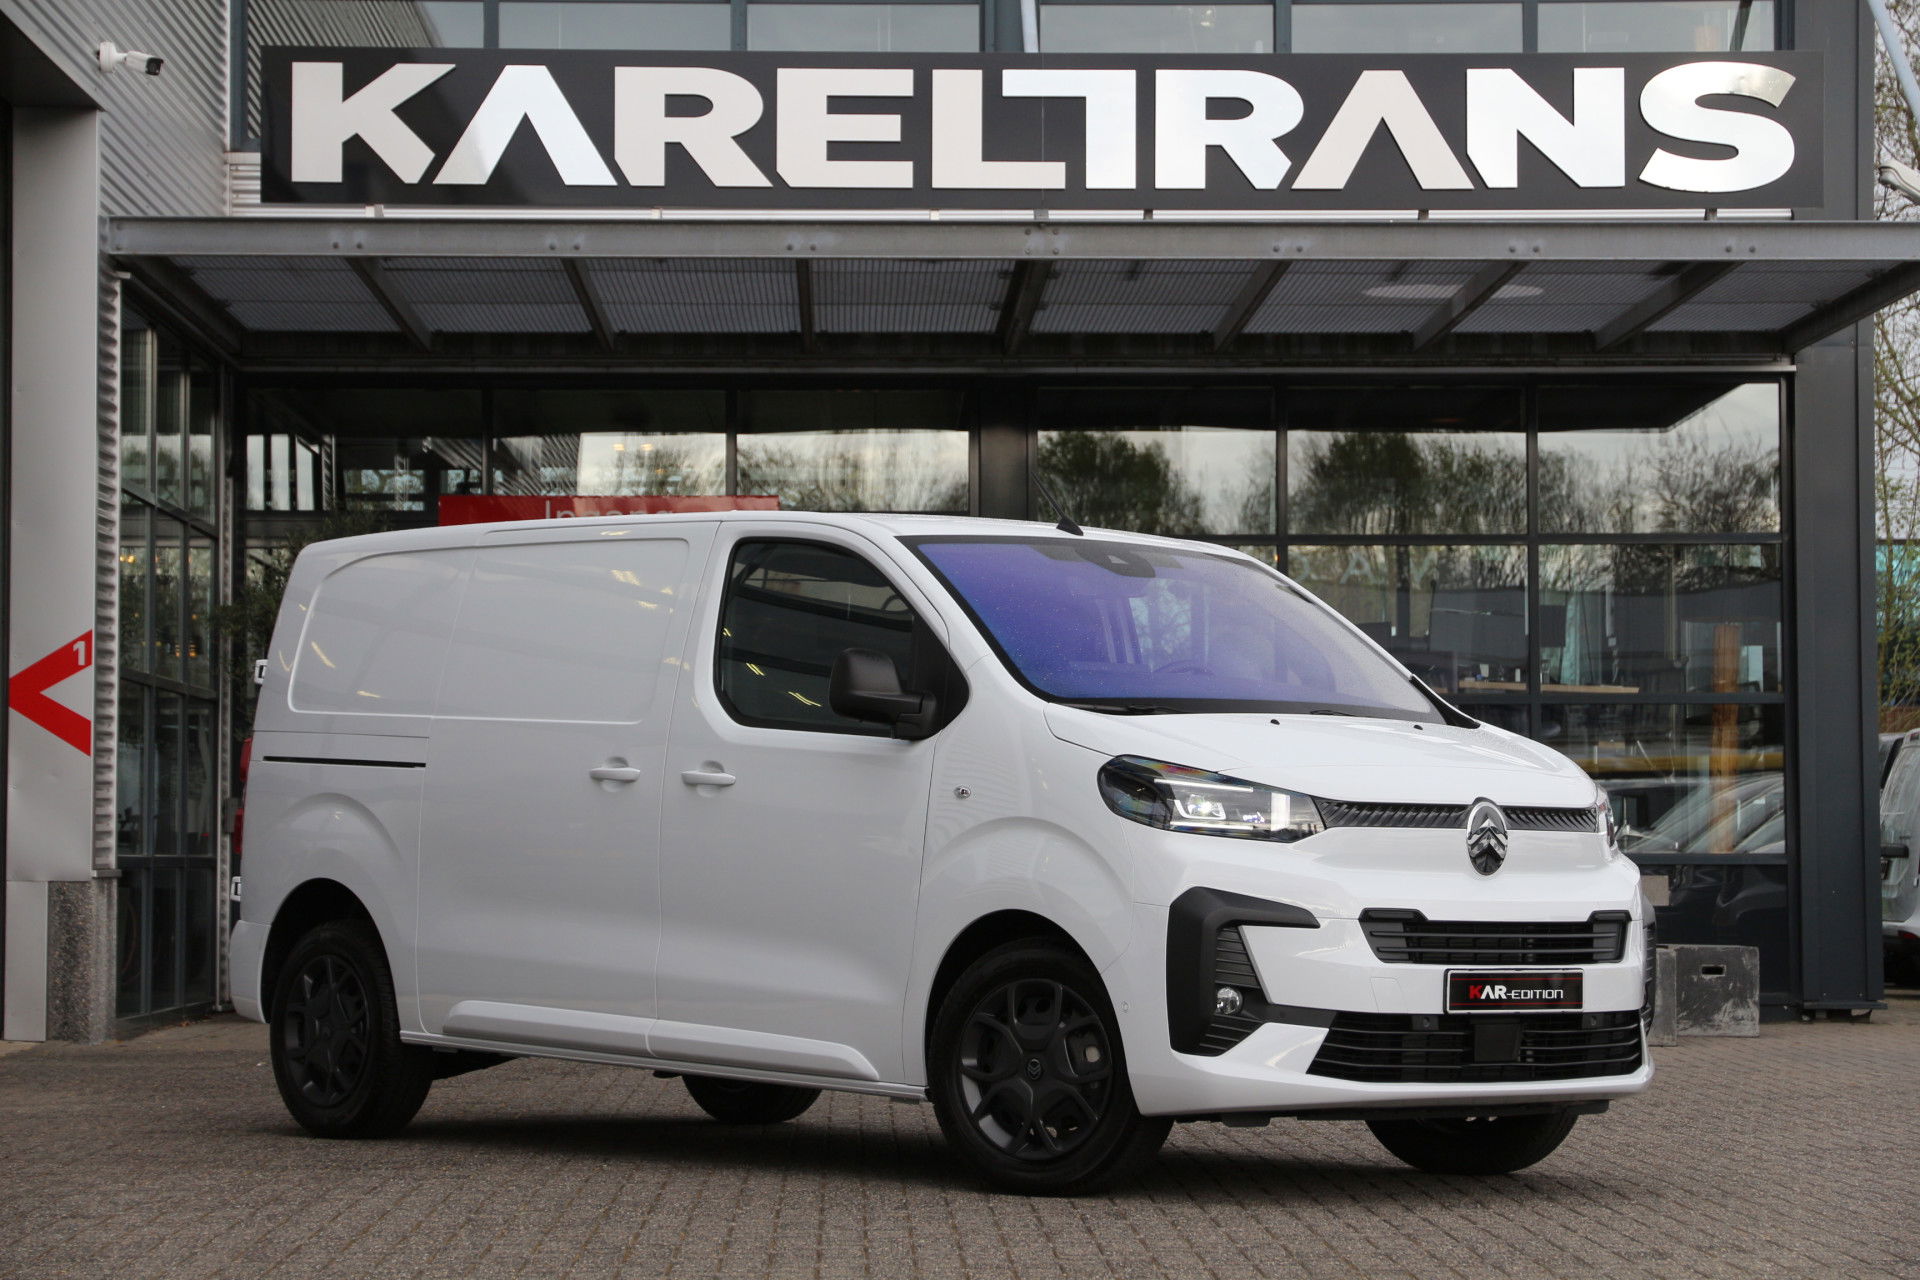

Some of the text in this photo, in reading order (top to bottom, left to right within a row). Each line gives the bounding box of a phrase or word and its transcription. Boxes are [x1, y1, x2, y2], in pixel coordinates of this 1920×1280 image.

[291, 61, 1796, 193] KARELTRANS
[72, 640, 86, 666] 1
[1468, 984, 1564, 1000] KAR-EDITION
